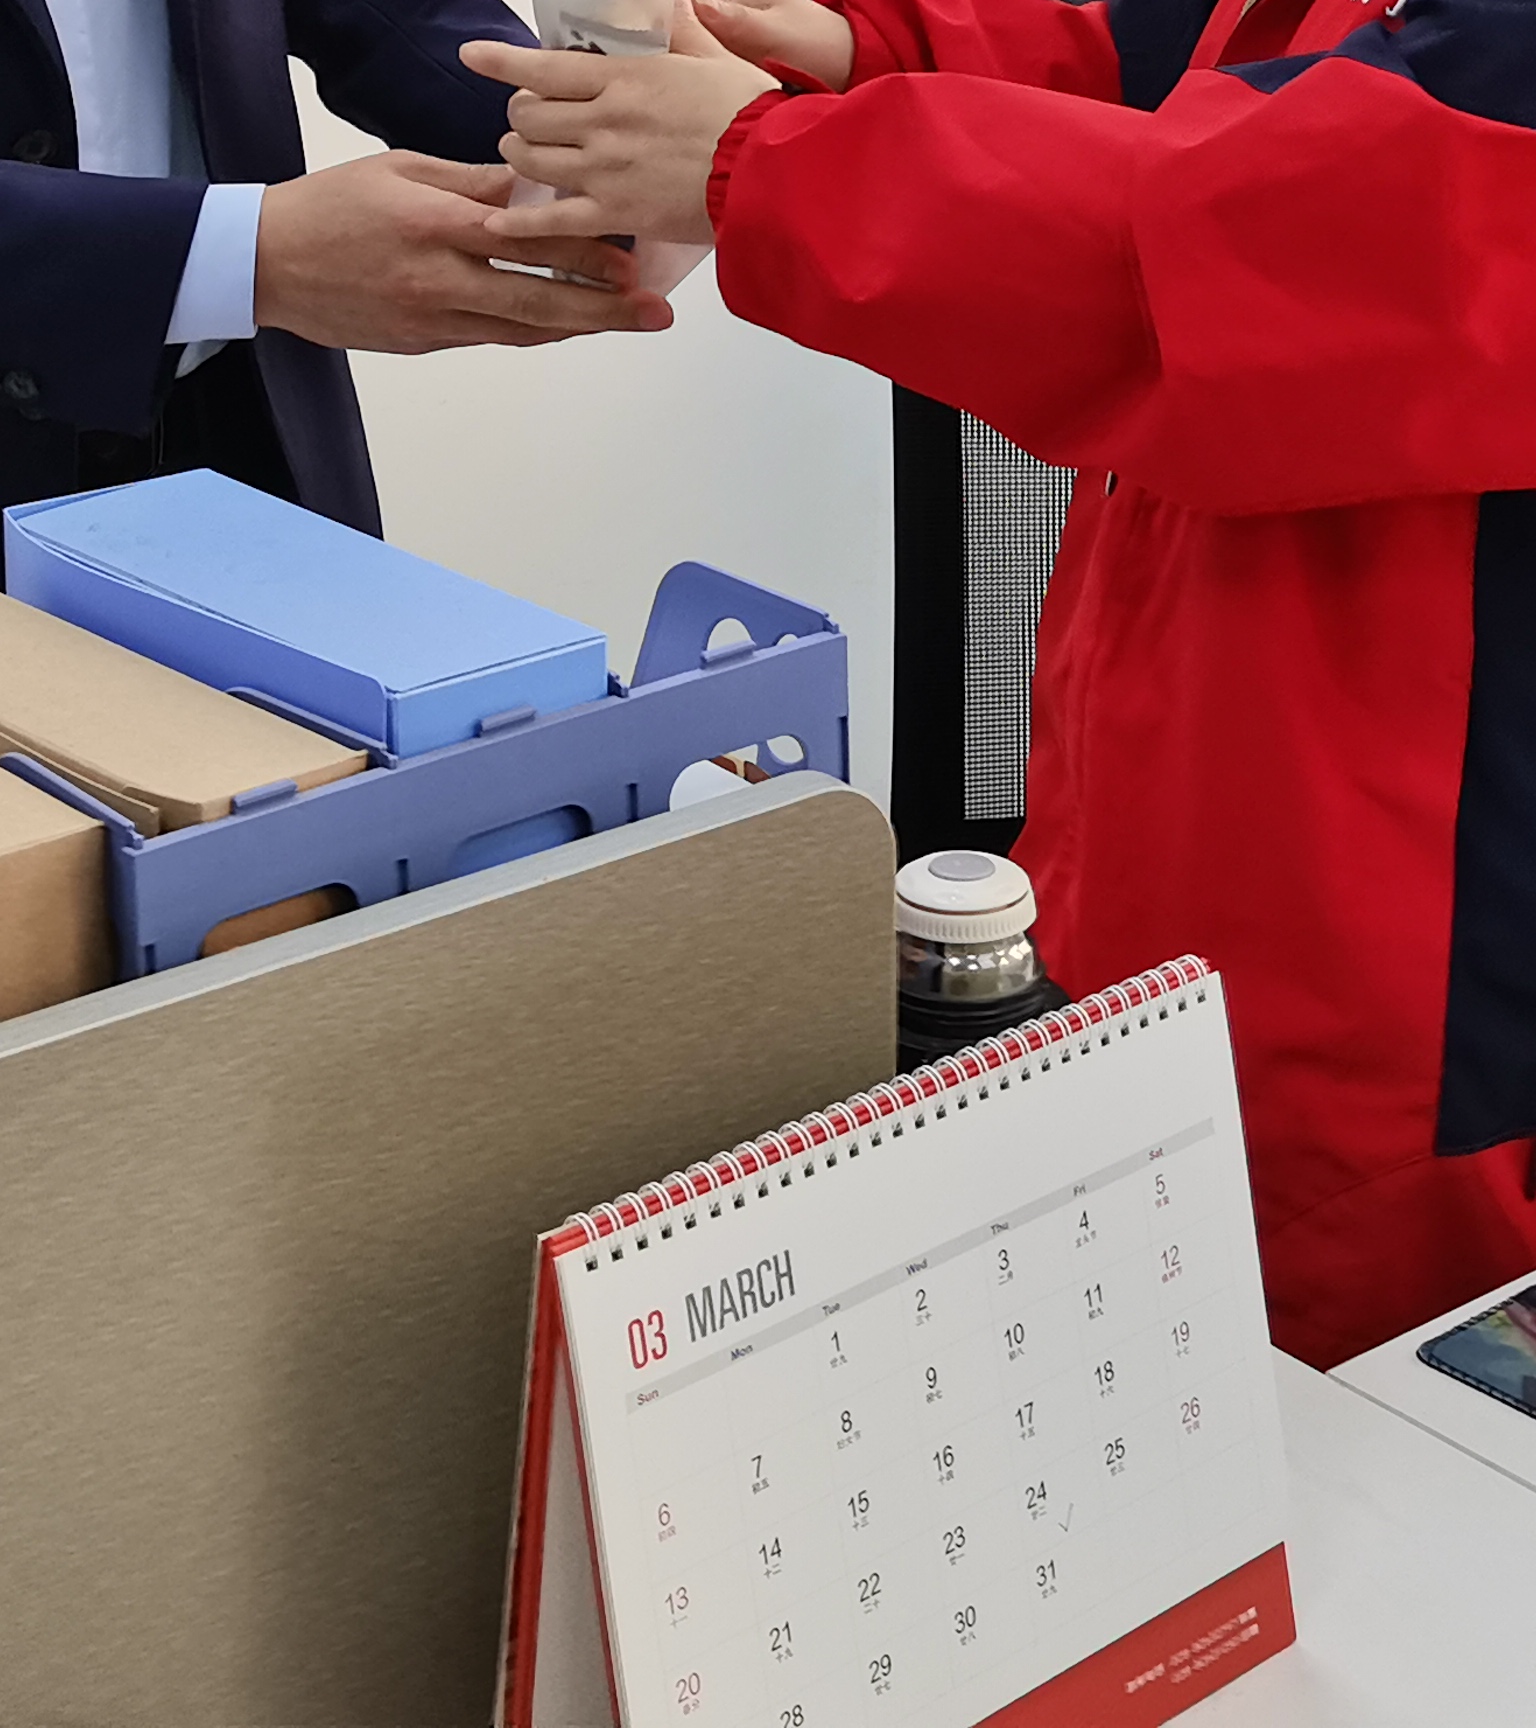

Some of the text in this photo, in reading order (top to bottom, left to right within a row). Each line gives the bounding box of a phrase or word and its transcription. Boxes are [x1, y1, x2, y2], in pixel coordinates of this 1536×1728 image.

[627, 1249, 796, 1370] 03 MARCH
[636, 1388, 659, 1405] Sun
[730, 1344, 753, 1360] Mon
[821, 1302, 840, 1315] Tue
[1072, 1183, 1086, 1196] Fri
[1148, 1147, 1163, 1160] Sat
[657, 1245, 1180, 1525] 6 7 8 9 10 11 12
[829, 1173, 1165, 1352] 1 2 3 4 5
[664, 1321, 1189, 1614] 13 14 15 16 17 18 19
[675, 1396, 1200, 1703] 20 21 22 23 24 25 26
[779, 1559, 1056, 1728] 28 29 30 31
